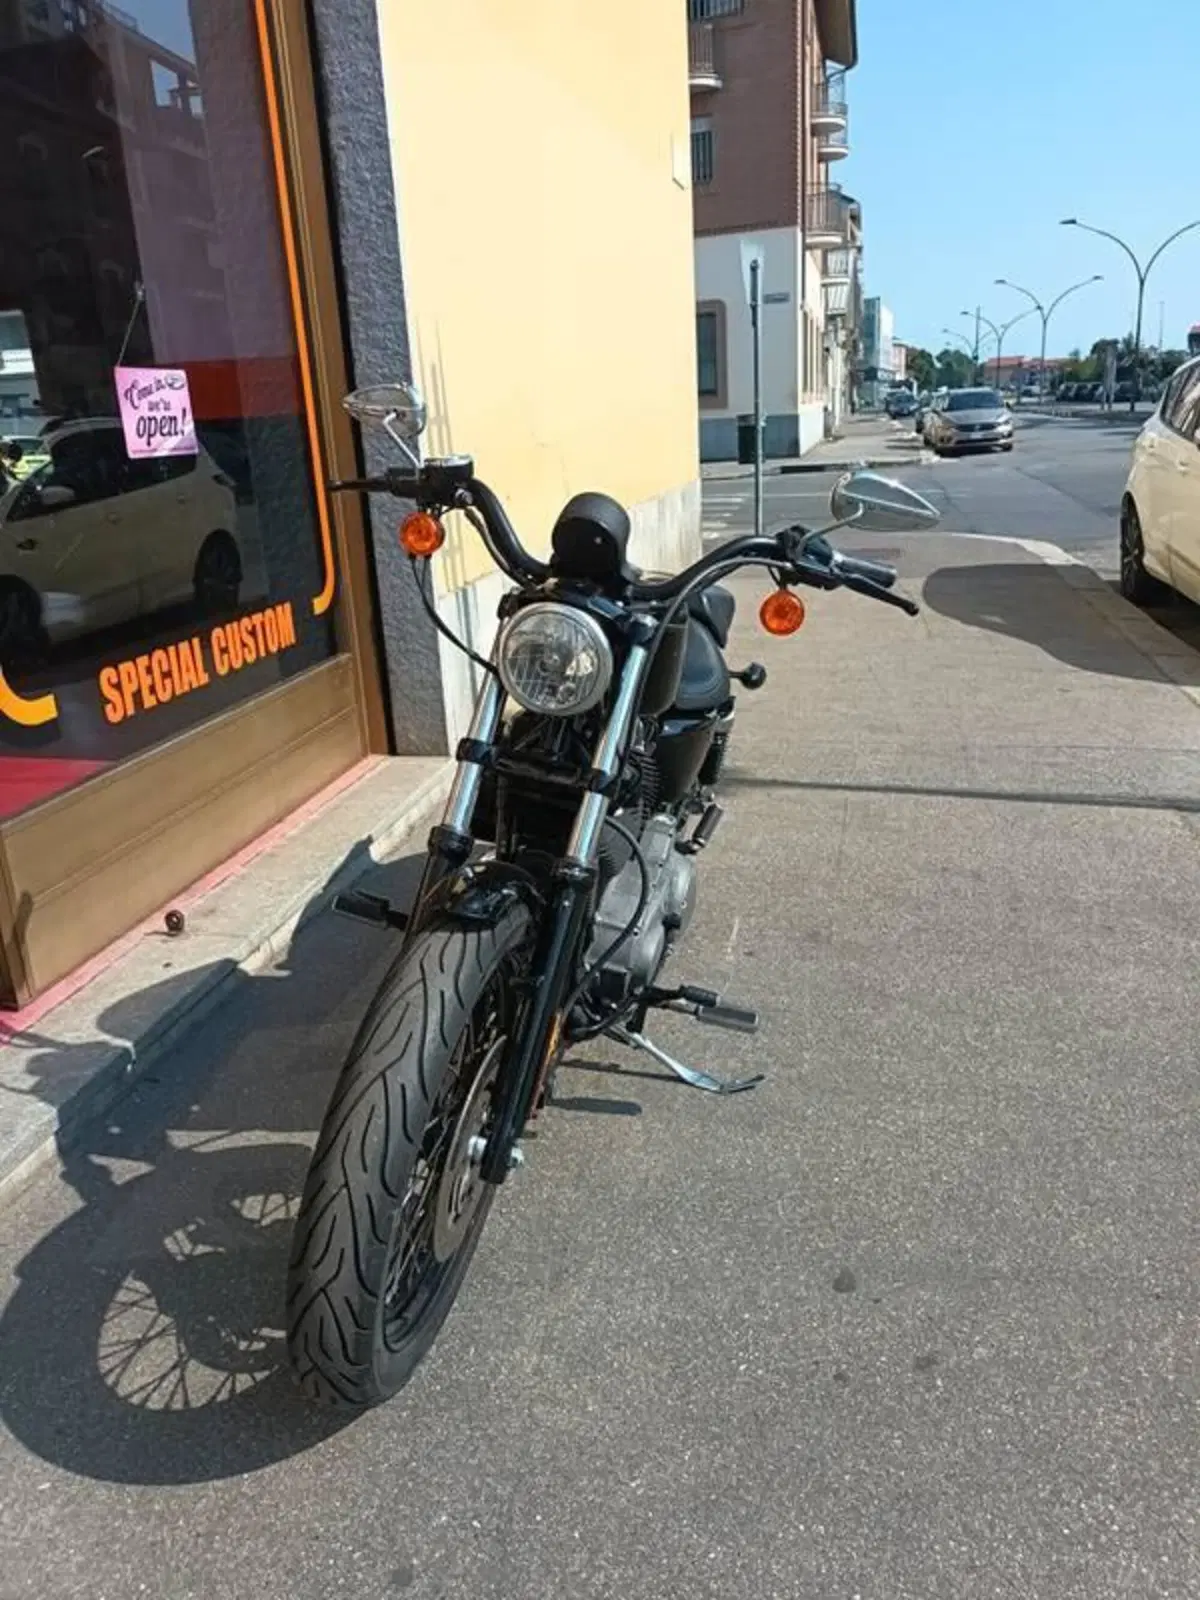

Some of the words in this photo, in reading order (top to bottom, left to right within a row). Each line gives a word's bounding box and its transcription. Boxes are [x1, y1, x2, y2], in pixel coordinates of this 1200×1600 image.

[136, 407, 186, 447] open!
[100, 637, 209, 723] SPECIAL
[211, 601, 296, 676] CUSTOM
